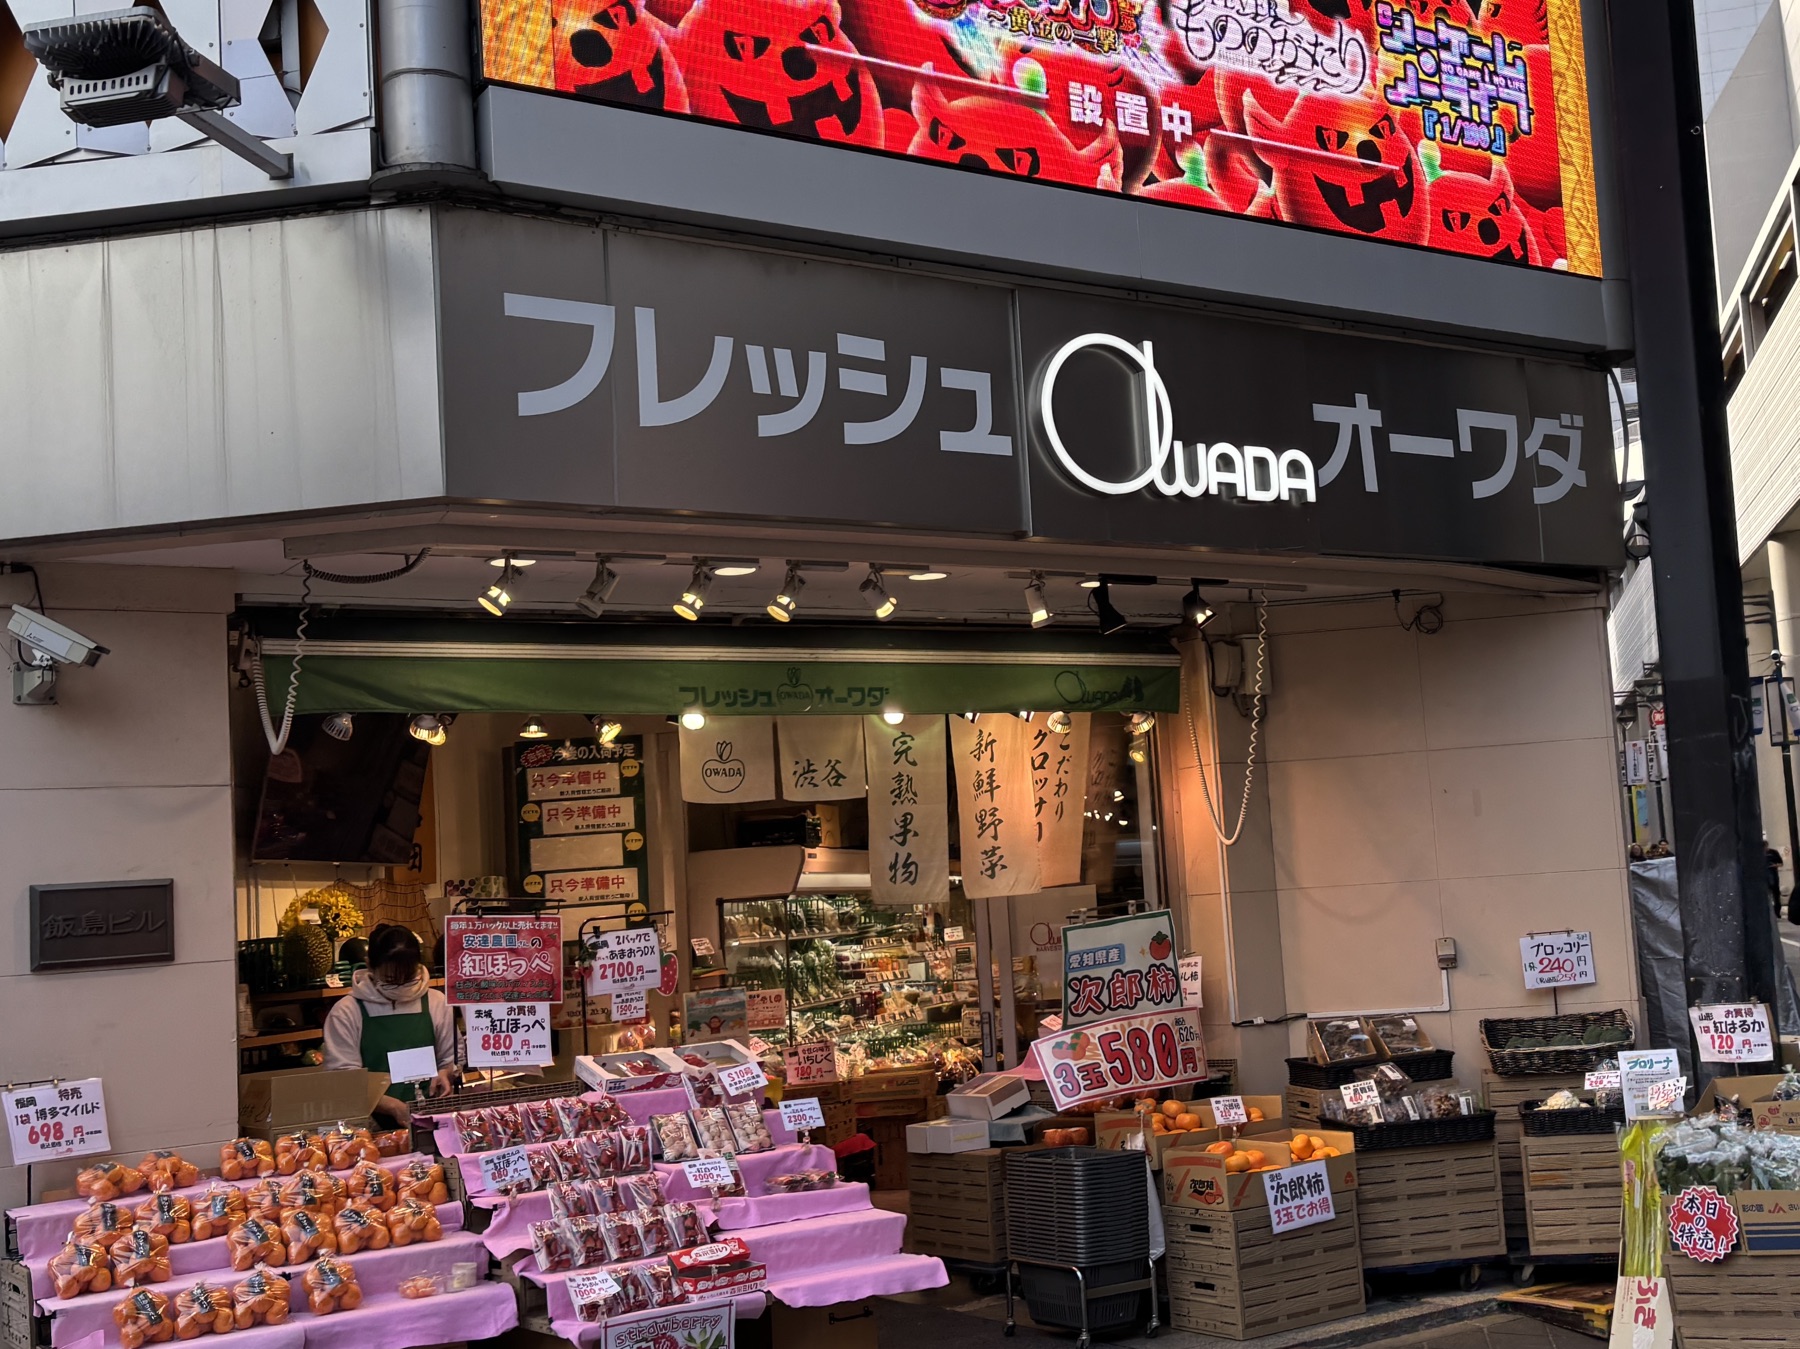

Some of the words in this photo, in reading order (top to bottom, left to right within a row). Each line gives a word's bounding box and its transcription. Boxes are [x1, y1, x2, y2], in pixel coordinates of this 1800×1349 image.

[1068, 81, 1193, 143] 設置中
[503, 292, 1014, 456] フレッシュ
[1312, 392, 1588, 505] オーワダ
[678, 686, 776, 708] フレッシュ
[814, 686, 890, 707] オーワダ
[531, 769, 607, 789] 只今準備中
[704, 767, 743, 778] OWADA
[792, 758, 848, 790] 渋谷
[1052, 732, 1073, 824] こだわり
[546, 804, 622, 823] 只今準備中
[889, 730, 920, 887] 完熟果物
[968, 728, 1008, 880] 新鮮野菜
[550, 874, 626, 894] 只今準備中
[39, 911, 167, 940] 飯島ビル
[609, 945, 656, 960] あまおうDX
[1069, 948, 1121, 968] 愛知県産
[1530, 941, 1590, 957] ブロッコリー
[459, 951, 554, 978] 紅ほっぺ
[599, 961, 634, 980] 2700
[636, 965, 644, 976] 円
[1538, 957, 1574, 974] 240
[1577, 955, 1587, 966] 円
[1069, 967, 1176, 1014] 次郎柿
[506, 1005, 536, 1016] お買得
[1724, 1008, 1754, 1019] お買得
[489, 1018, 546, 1034] 紅ほっぺ
[1179, 1027, 1194, 1042] 626
[1713, 1019, 1765, 1035] 紅はるか
[481, 1034, 513, 1051] 880
[520, 1039, 531, 1050] 円
[1710, 1034, 1734, 1050] 120
[1742, 1039, 1752, 1049] 円
[797, 1053, 833, 1066] いちじく
[1053, 1062, 1108, 1099] 3玉
[1098, 1022, 1179, 1085] 580
[1181, 1047, 1198, 1074] 円
[58, 1087, 82, 1101] 特売
[35, 1102, 100, 1121] 博多マイルド
[28, 1121, 64, 1145] 698
[73, 1125, 84, 1138] 円
[692, 1173, 715, 1181] 2000
[1270, 1172, 1325, 1205] 次郎柿
[1274, 1196, 1331, 1226] 3玉でお得
[1683, 1194, 1718, 1218] 本日
[1695, 1216, 1706, 1228] の
[615, 1315, 721, 1347] strawberry
